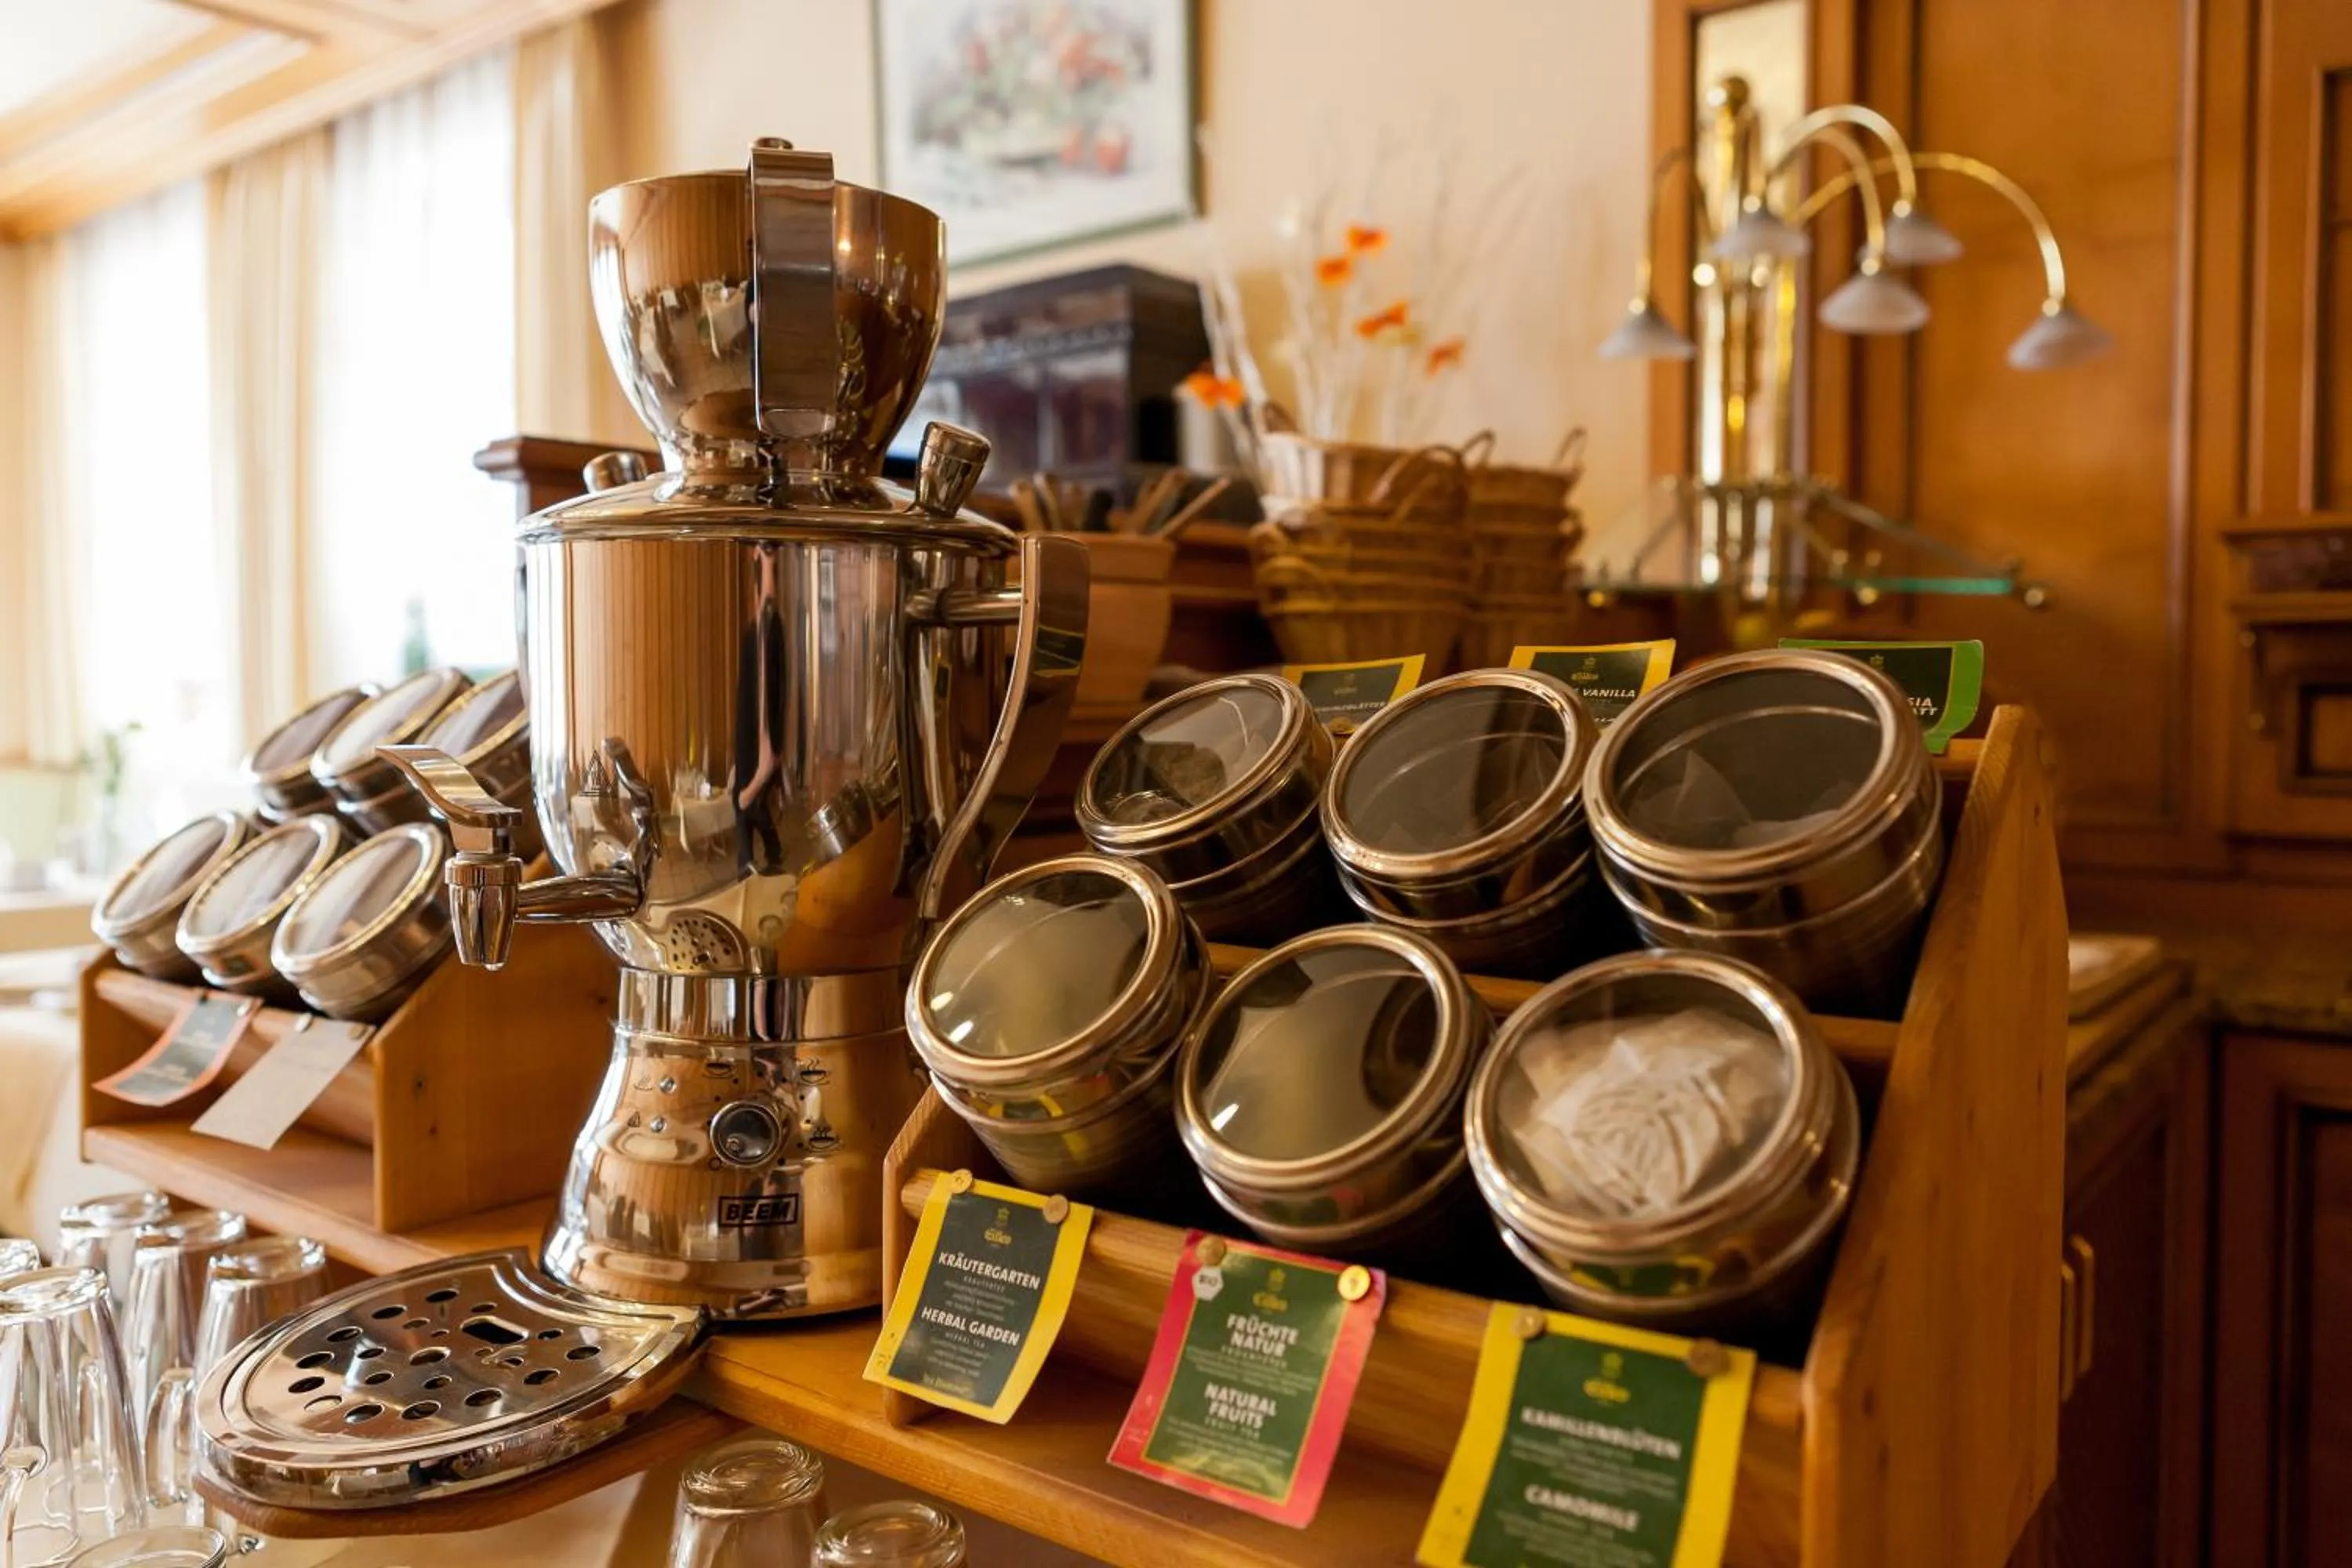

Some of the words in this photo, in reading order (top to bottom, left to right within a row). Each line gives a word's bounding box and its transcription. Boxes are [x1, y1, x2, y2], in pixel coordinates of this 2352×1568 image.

[1907, 697, 1933, 706] SIA
[727, 1200, 791, 1220] BEEM
[938, 1251, 1041, 1290] KRÄUTERGARTEN
[921, 1307, 966, 1332] HERBAL
[969, 1320, 1020, 1346] GARDEN
[1227, 1313, 1299, 1345] FRÜCHTE
[1231, 1331, 1287, 1357] NATUR
[1204, 1381, 1276, 1417] NATURAL
[1209, 1400, 1265, 1429] FRUITS
